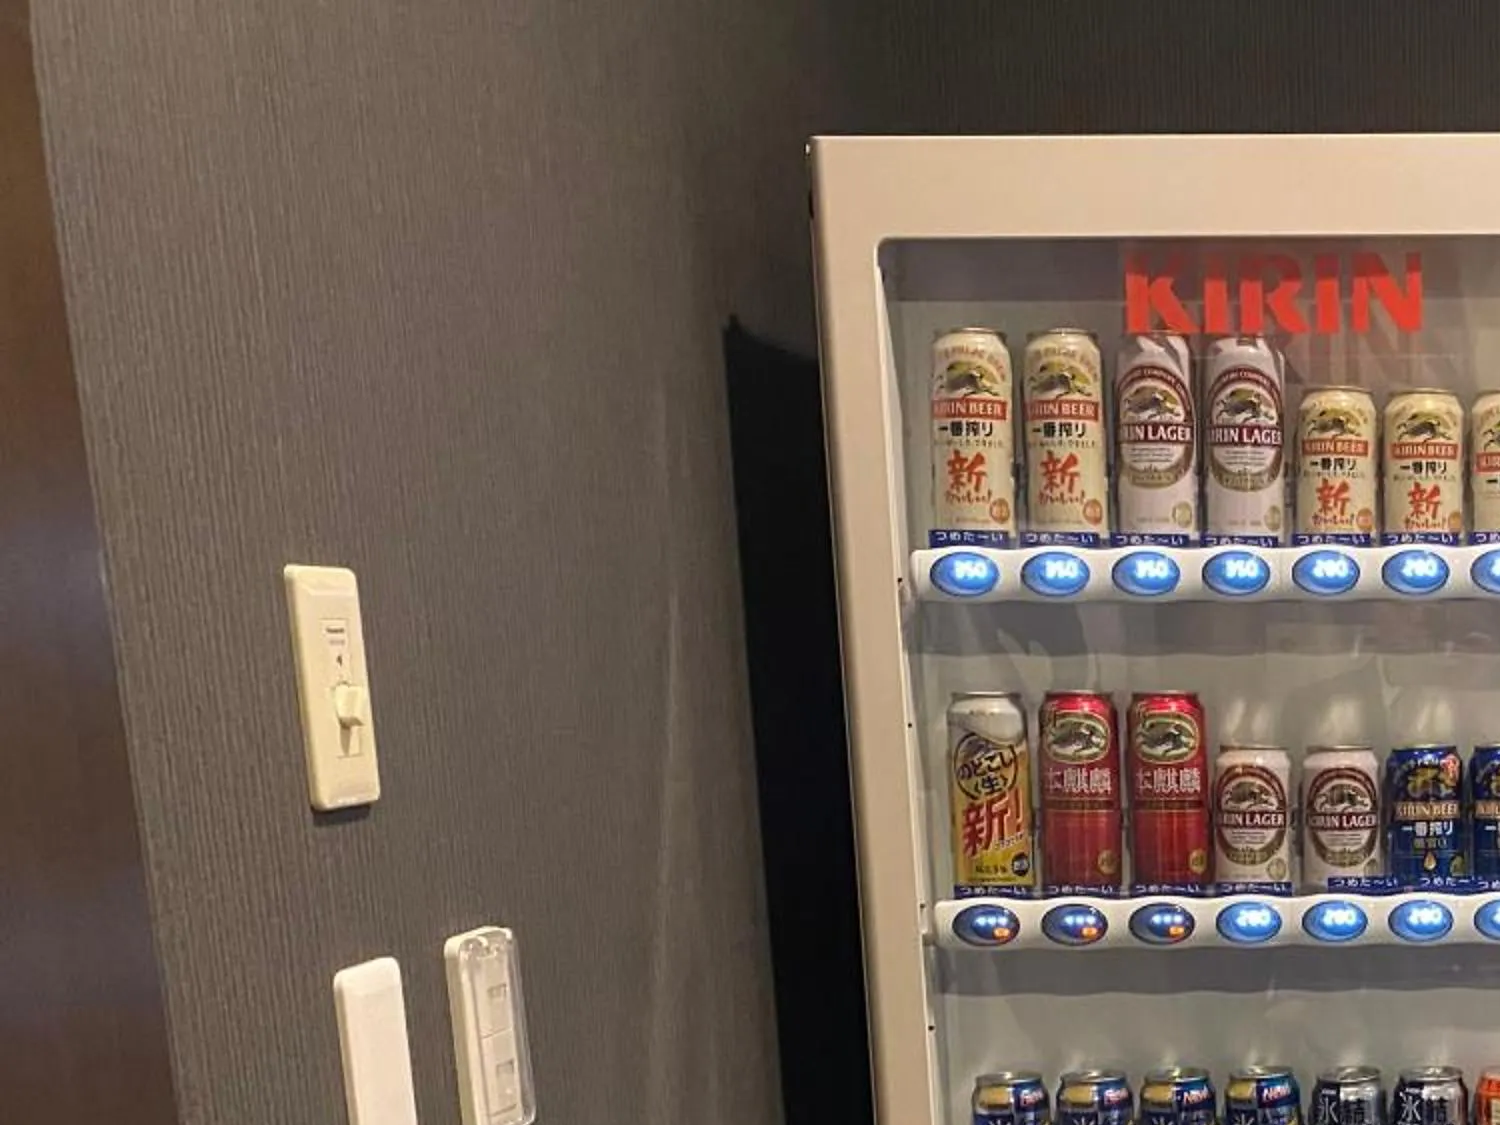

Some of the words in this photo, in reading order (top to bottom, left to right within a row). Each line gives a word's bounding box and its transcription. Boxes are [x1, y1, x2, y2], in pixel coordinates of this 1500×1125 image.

[1123, 250, 1424, 335] KIRIN
[1062, 402, 1095, 417] BEER
[1120, 425, 1145, 440] RIN
[1147, 426, 1191, 441] LAGER
[1243, 430, 1281, 444] LAGER
[947, 450, 988, 491] 新
[1040, 450, 1080, 492] 新
[1316, 478, 1351, 515] 新
[1408, 481, 1443, 519] 新
[957, 750, 1013, 781] のどごし
[1221, 813, 1243, 825] RIN
[1245, 813, 1284, 825] LAGER
